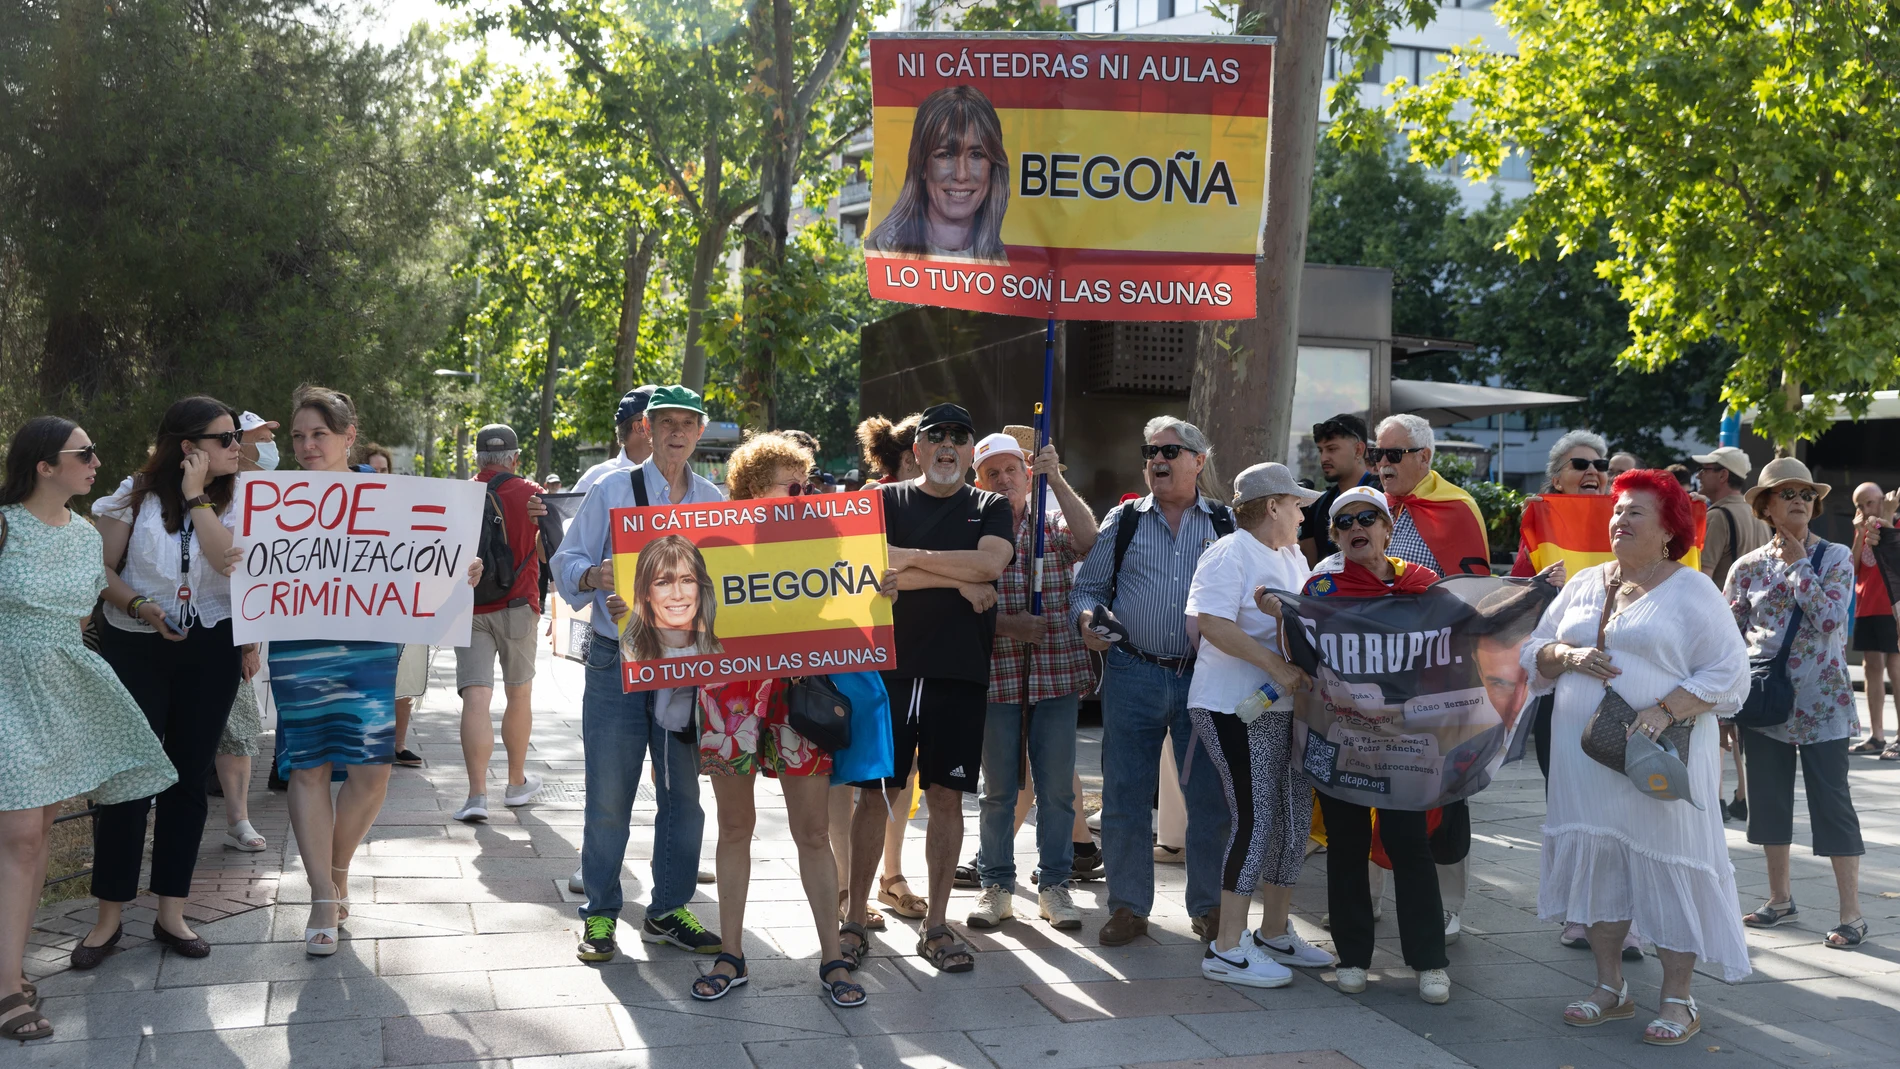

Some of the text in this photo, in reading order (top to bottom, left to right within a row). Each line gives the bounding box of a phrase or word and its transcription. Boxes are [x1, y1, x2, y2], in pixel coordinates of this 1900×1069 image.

[897, 48, 1241, 85] NI CÁTEDRAS NI AULAS
[1020, 150, 1239, 206] BEGOÑA
[885, 265, 1233, 306] LO TUYO SON LAS SAUNAS
[242, 480, 391, 537] PSOE
[622, 497, 872, 532] NI CÁTEDRAS NI AULAS
[722, 560, 882, 606] BEGOÑA
[628, 646, 888, 685] LO TUYO SON LAS SAUNAS
[1339, 773, 1385, 792] elcapo.org
